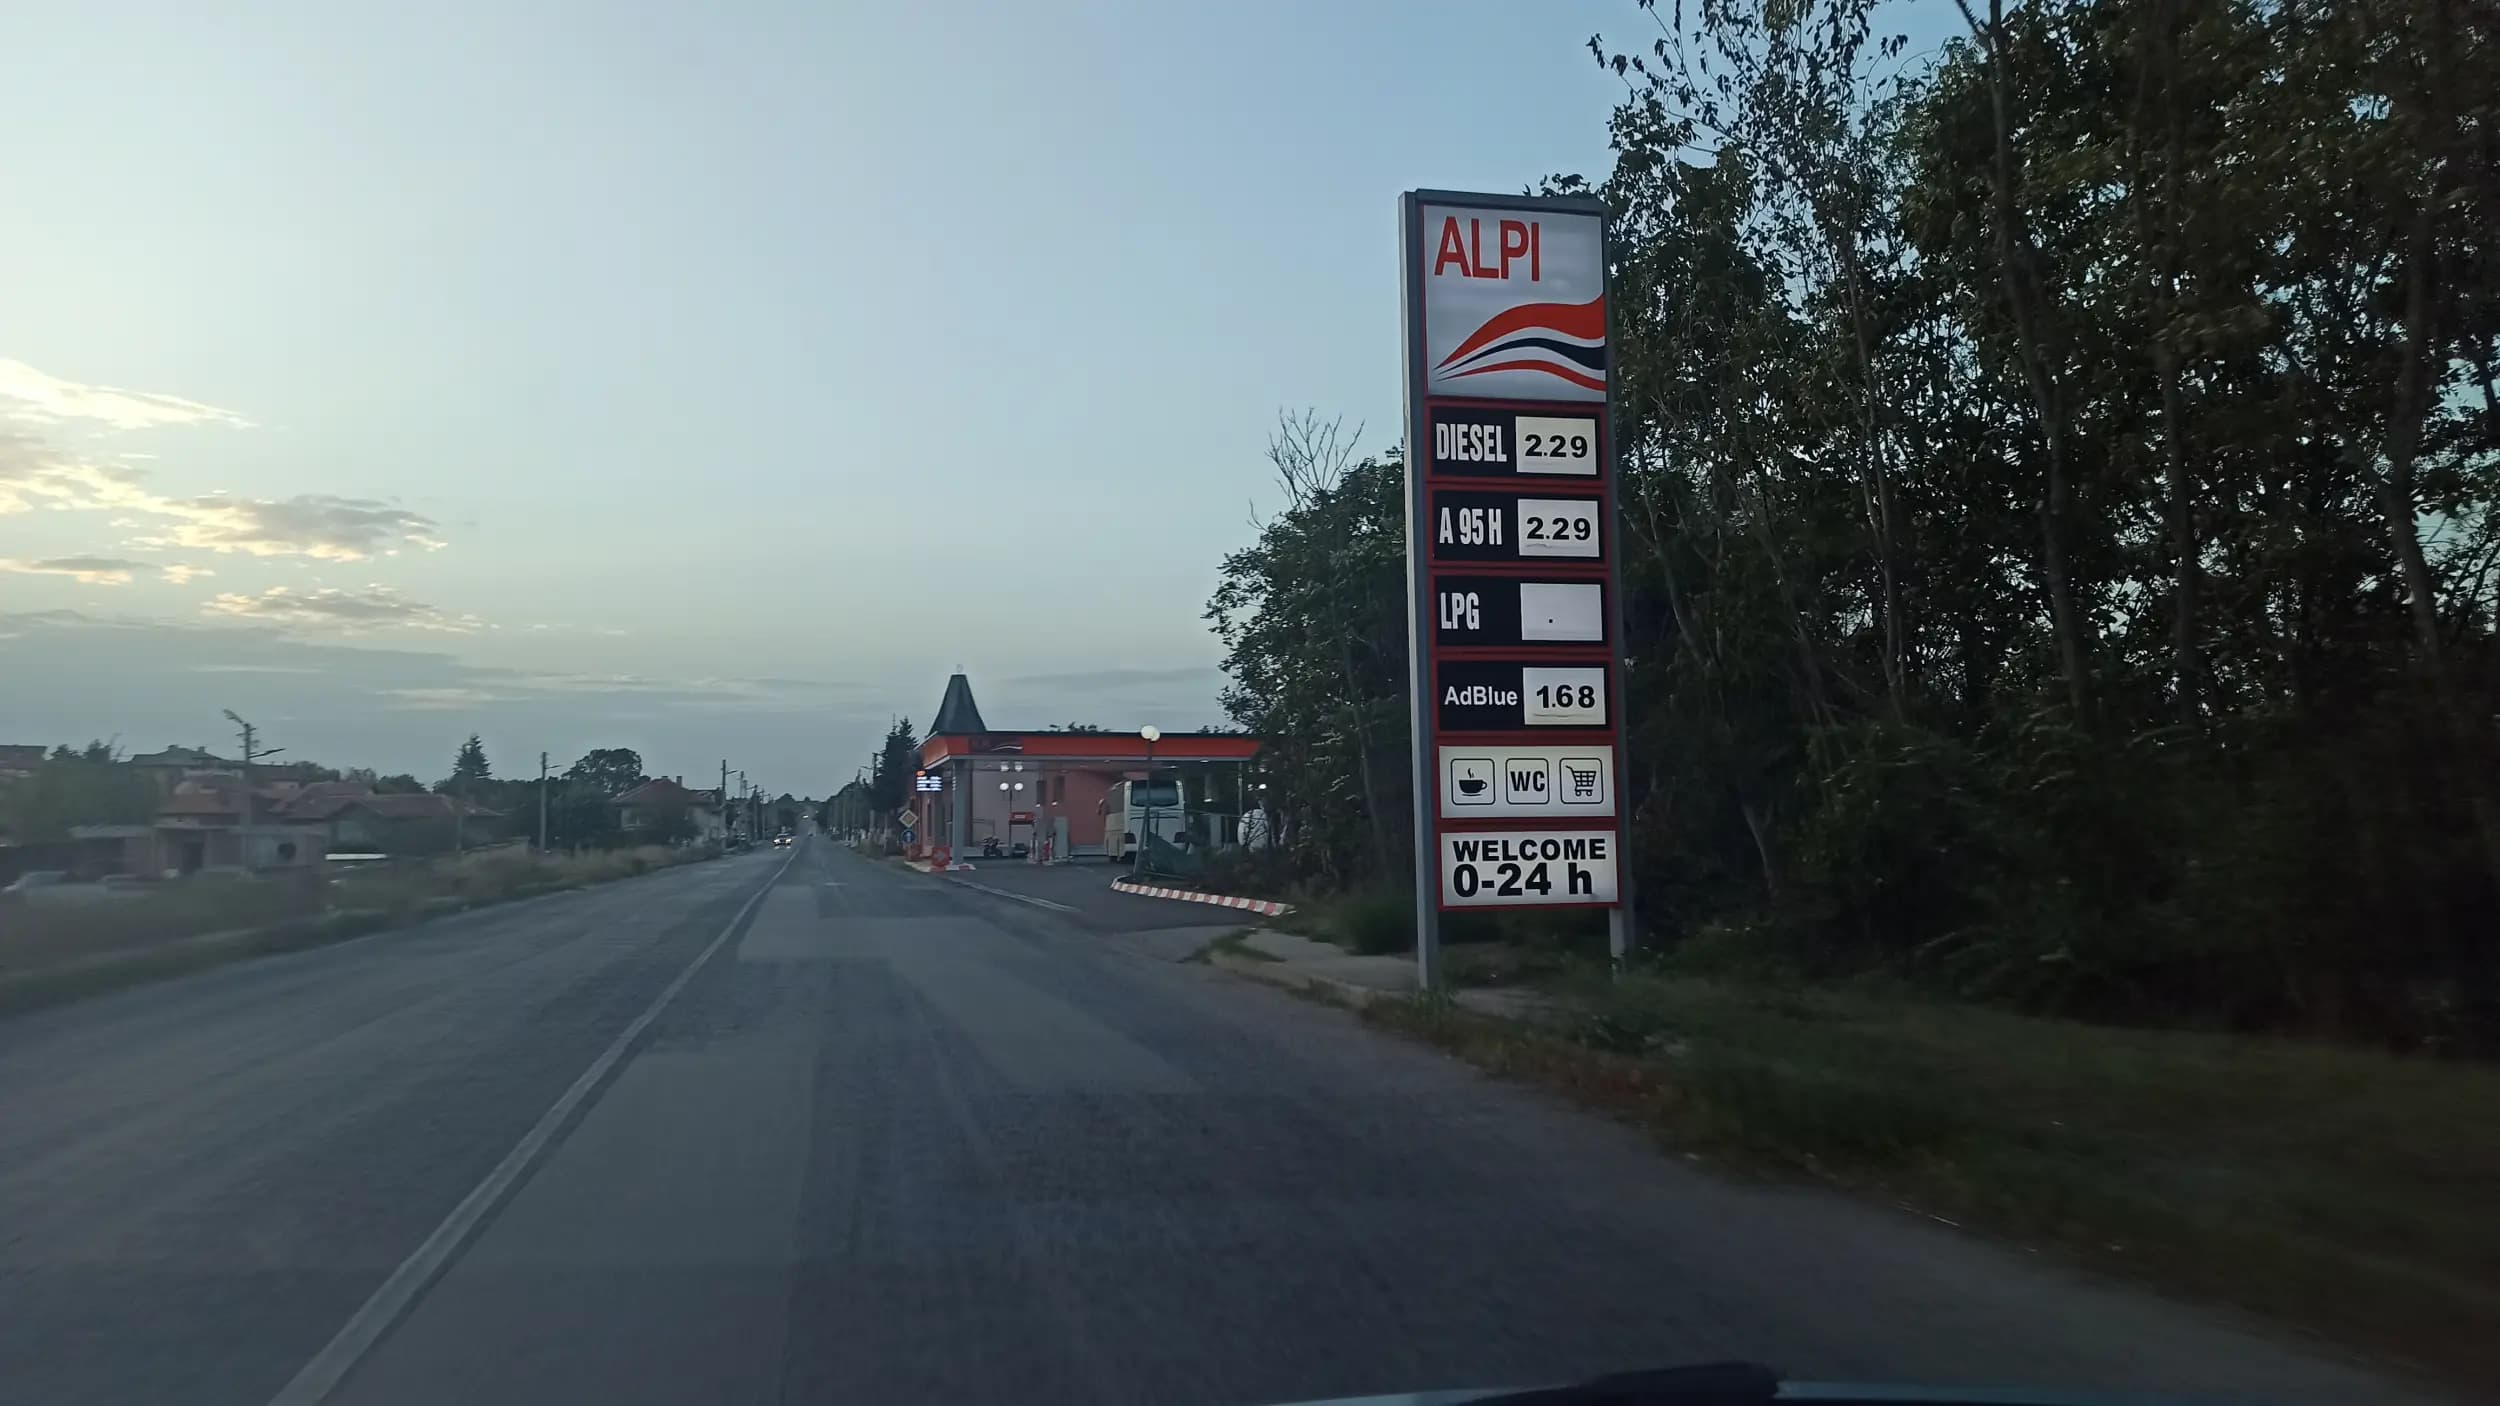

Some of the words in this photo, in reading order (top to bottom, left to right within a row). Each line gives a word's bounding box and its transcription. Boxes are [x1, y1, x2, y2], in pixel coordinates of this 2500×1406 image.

[1434, 215, 1540, 282] ALPI
[1436, 423, 1507, 462] DIESEL
[1524, 434, 1588, 458] 2.29
[1439, 507, 1453, 544] A
[1459, 508, 1483, 545] 95
[1488, 508, 1502, 545] H
[1526, 517, 1591, 540] 2.29
[1440, 592, 1480, 630] LPG
[1444, 686, 1518, 705] AdBlue
[1536, 685, 1596, 709] 1.68
[1510, 771, 1545, 791] WC
[1452, 838, 1606, 862] WELCOME
[1453, 862, 1551, 897] 0-24
[1567, 862, 1592, 894] h
